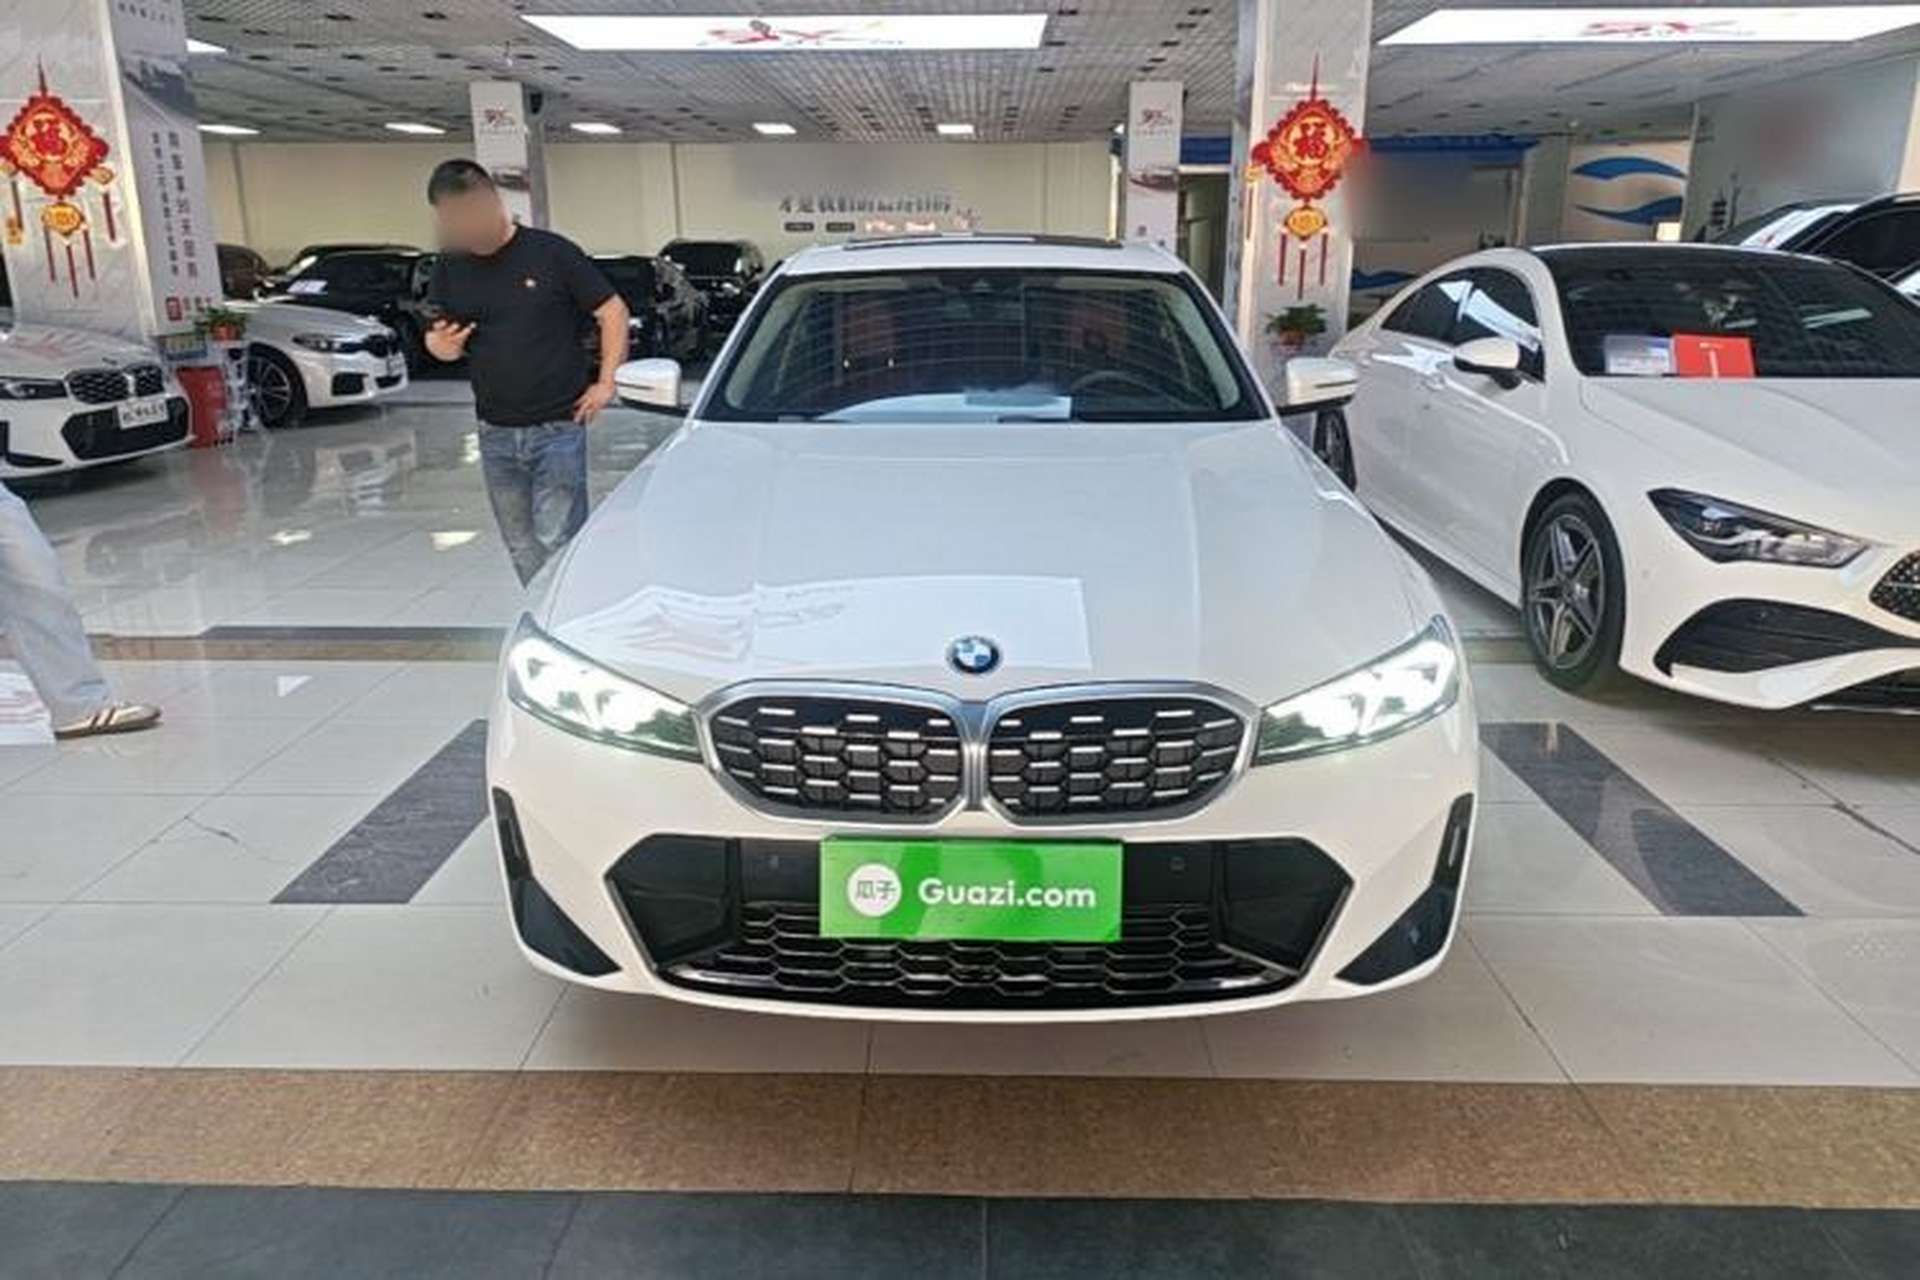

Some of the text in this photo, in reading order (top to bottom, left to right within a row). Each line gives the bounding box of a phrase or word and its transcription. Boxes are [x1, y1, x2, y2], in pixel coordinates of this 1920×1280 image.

[1294, 121, 1329, 159] 福
[855, 877, 1097, 908] 瓜子 Guazi.com
